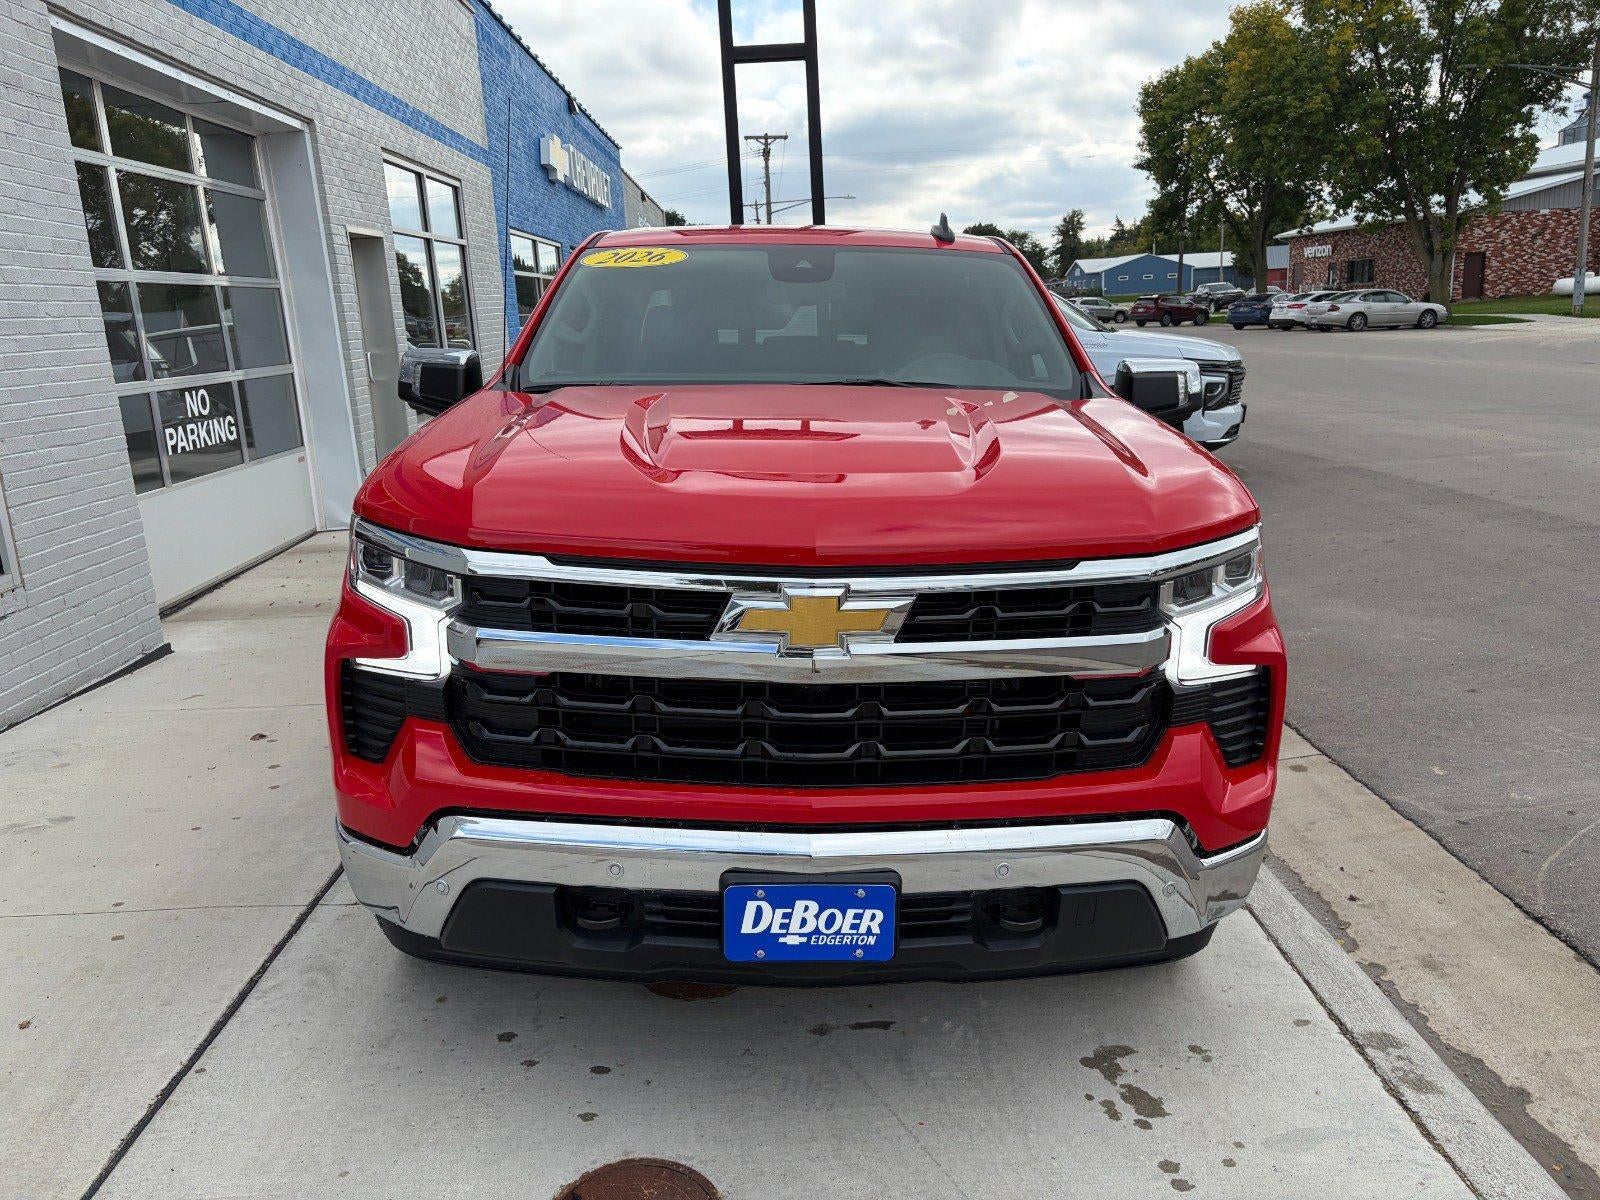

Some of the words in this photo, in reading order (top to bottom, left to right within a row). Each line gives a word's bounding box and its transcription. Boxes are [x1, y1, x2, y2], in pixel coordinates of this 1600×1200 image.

[1304, 244, 1332, 257] verizon
[595, 251, 672, 264] 2026
[185, 389, 210, 417] NO
[165, 415, 237, 455] PARKING
[810, 935, 877, 945] EDGERTON
